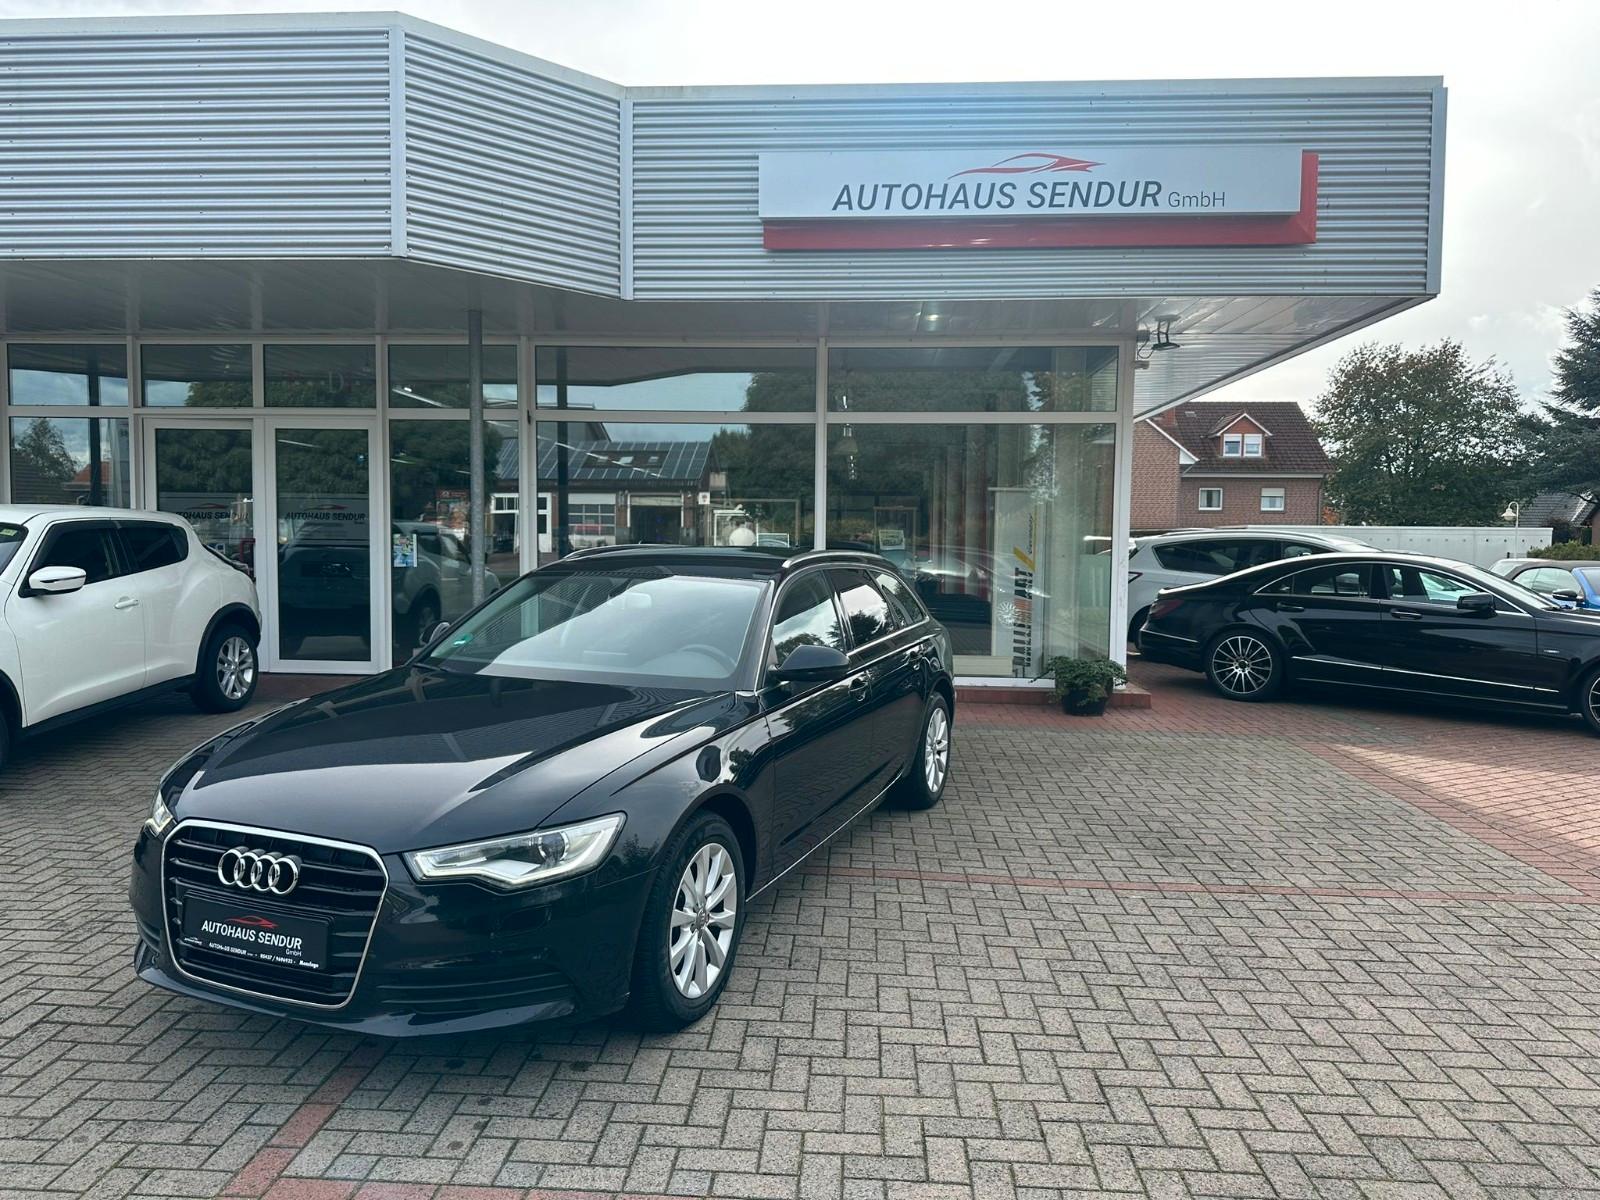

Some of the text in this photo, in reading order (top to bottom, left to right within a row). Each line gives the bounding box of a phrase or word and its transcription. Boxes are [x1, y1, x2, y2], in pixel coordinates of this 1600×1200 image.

[832, 180, 1226, 211] AUTOHAUS SENDUR GmbH
[285, 513, 366, 521] AUTOHAUS SENDUR
[201, 920, 256, 942] AUTOHAUS
[257, 931, 303, 950] SENDUR
[285, 948, 302, 957] GmbH
